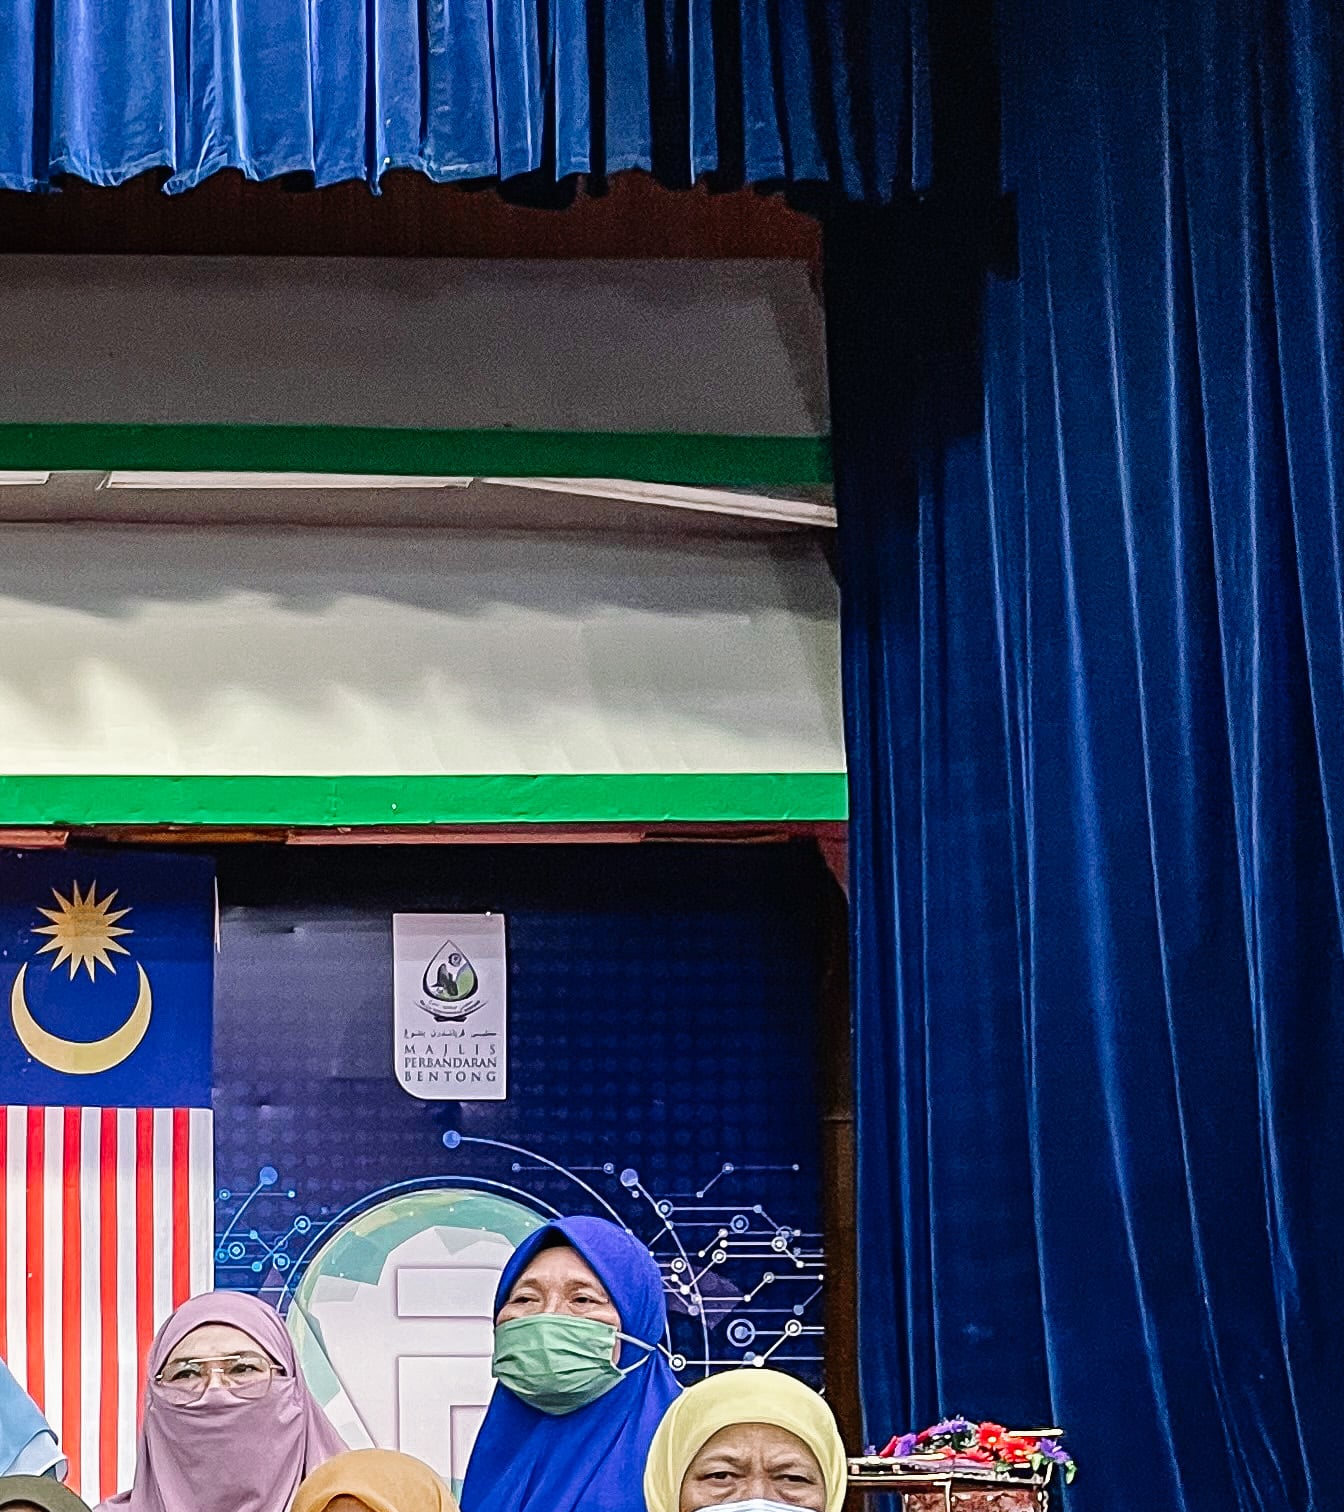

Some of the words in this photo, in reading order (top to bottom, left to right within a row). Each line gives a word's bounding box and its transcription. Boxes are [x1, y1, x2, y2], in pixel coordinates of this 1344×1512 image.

[404, 1043, 496, 1056] MAJLIS
[404, 1057, 497, 1069] PERBANDARAN
[404, 1070, 496, 1082] BENTONG
